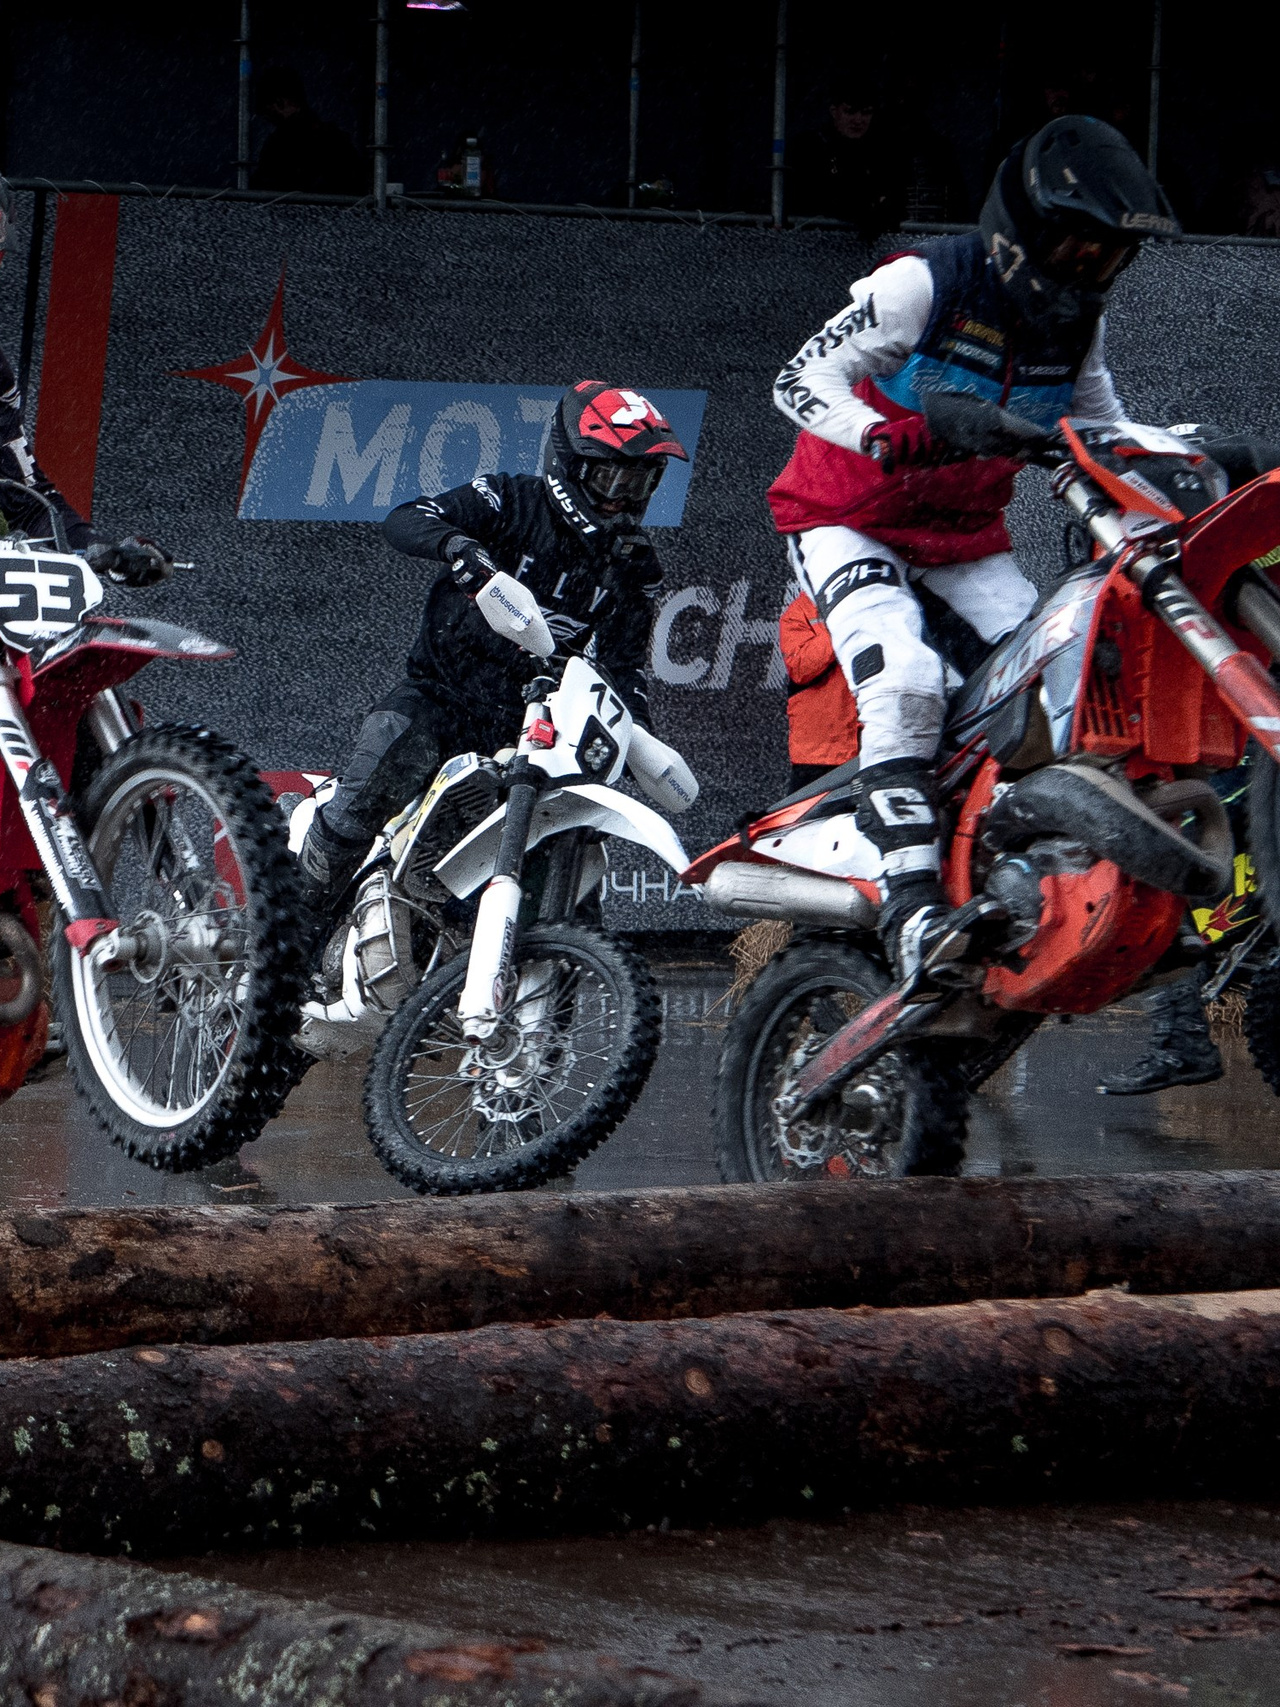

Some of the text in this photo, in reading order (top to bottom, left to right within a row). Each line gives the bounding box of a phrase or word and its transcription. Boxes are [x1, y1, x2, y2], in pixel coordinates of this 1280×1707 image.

[306, 396, 563, 506] МОТ
[496, 591, 532, 627] Husqvarna
[600, 870, 704, 903] ЧНА
